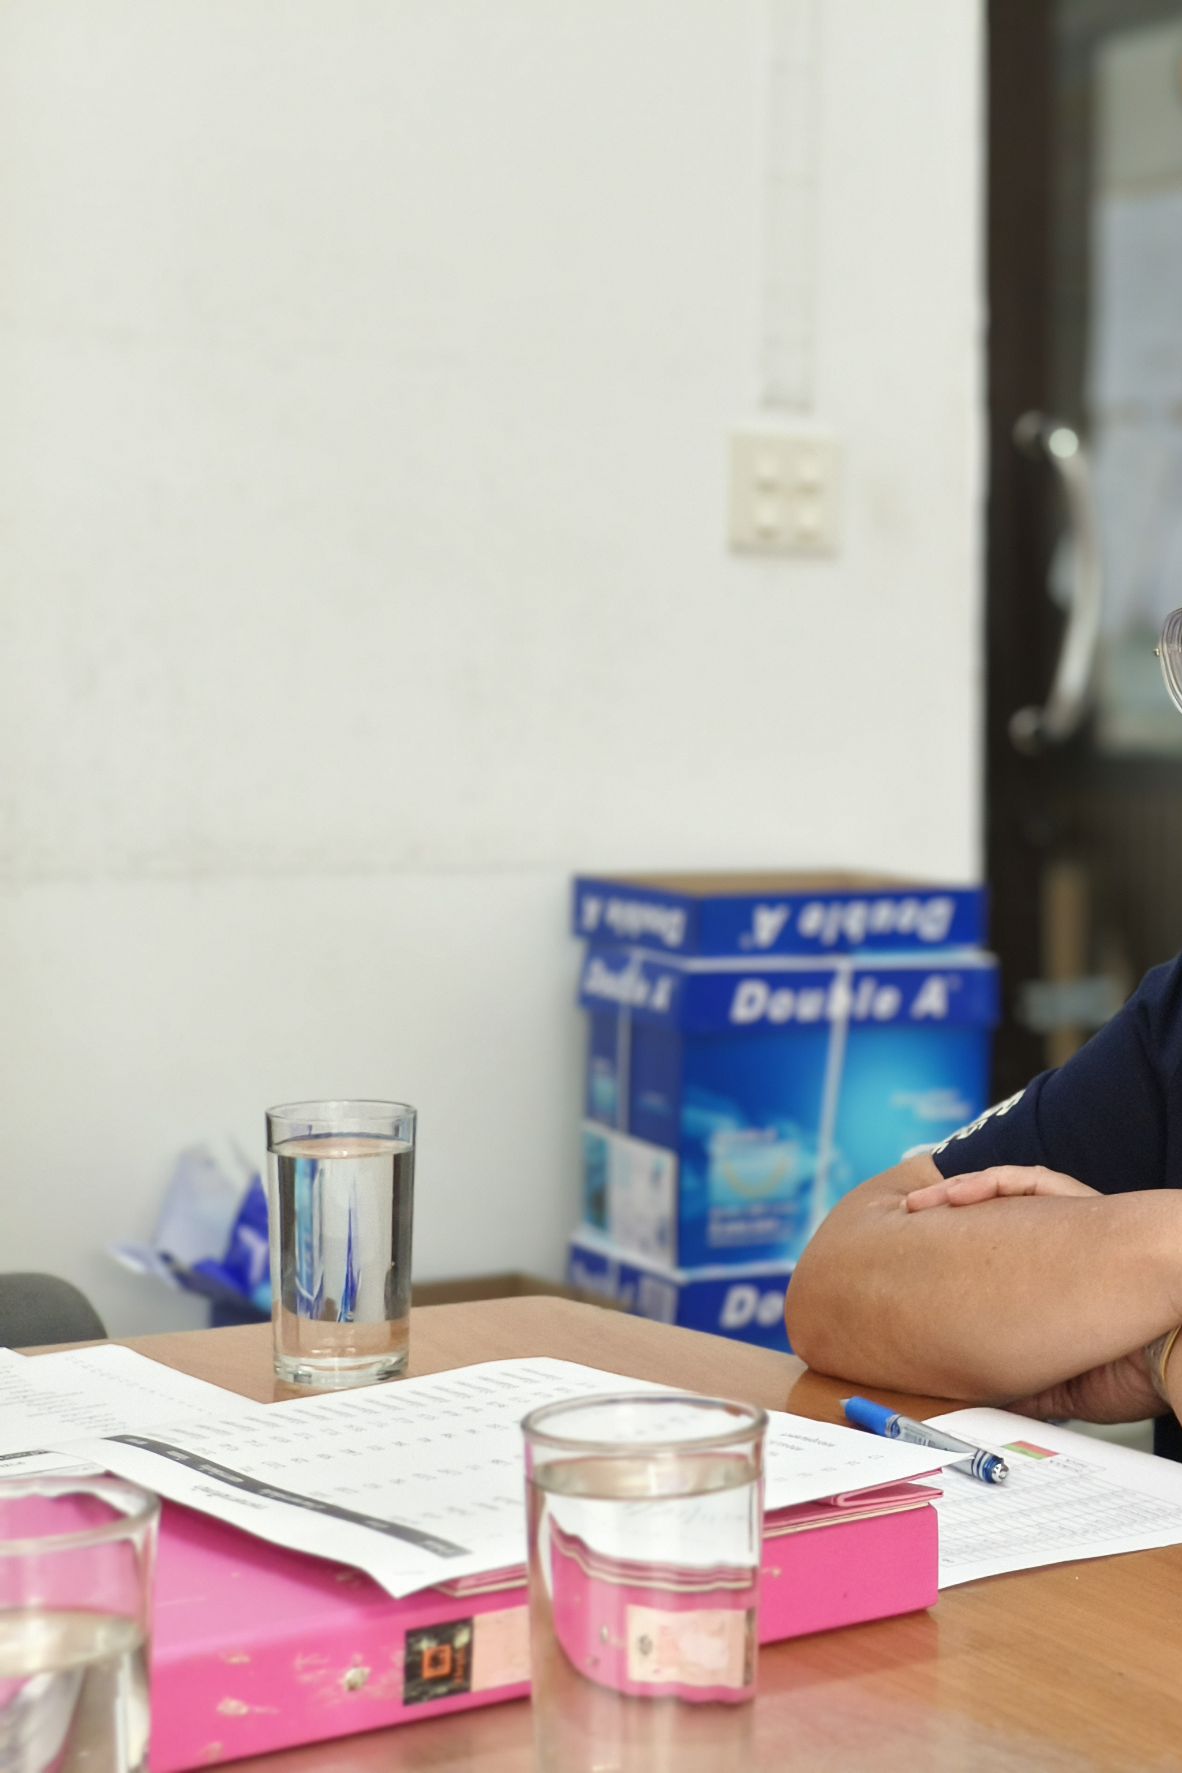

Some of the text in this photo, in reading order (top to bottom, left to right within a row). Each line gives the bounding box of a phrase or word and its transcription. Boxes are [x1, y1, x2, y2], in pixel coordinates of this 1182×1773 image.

[751, 897, 955, 949] Double A
[910, 974, 950, 1021] A
